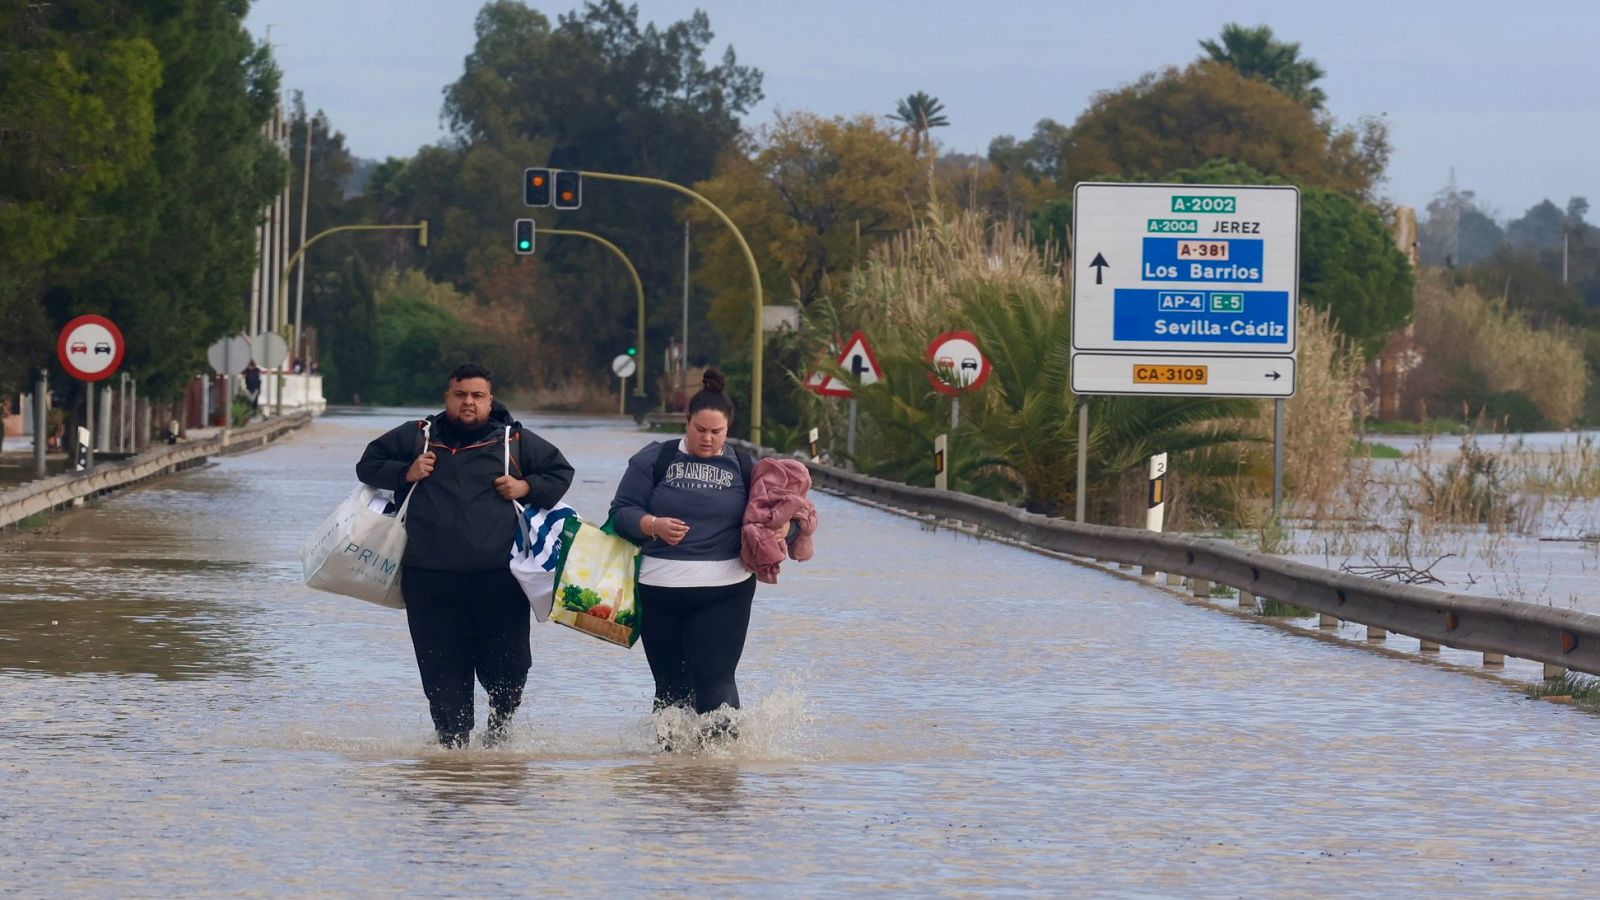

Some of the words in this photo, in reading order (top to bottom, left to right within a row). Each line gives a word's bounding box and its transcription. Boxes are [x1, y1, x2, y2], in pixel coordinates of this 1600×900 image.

[1174, 198, 1234, 212] A-2002
[1149, 221, 1196, 232] A-2004
[1212, 221, 1260, 234] JEREZ
[1180, 245, 1226, 257] A-381
[1145, 263, 1178, 278] Los
[1190, 264, 1260, 280] Barrios
[1162, 295, 1201, 309] AP-4
[1213, 296, 1240, 309] E-5
[1154, 319, 1284, 337] Sevilla-Cádiz
[1137, 368, 1204, 381] CA-3109
[684, 462, 733, 487] ANGELES
[1157, 462, 1165, 473] 2
